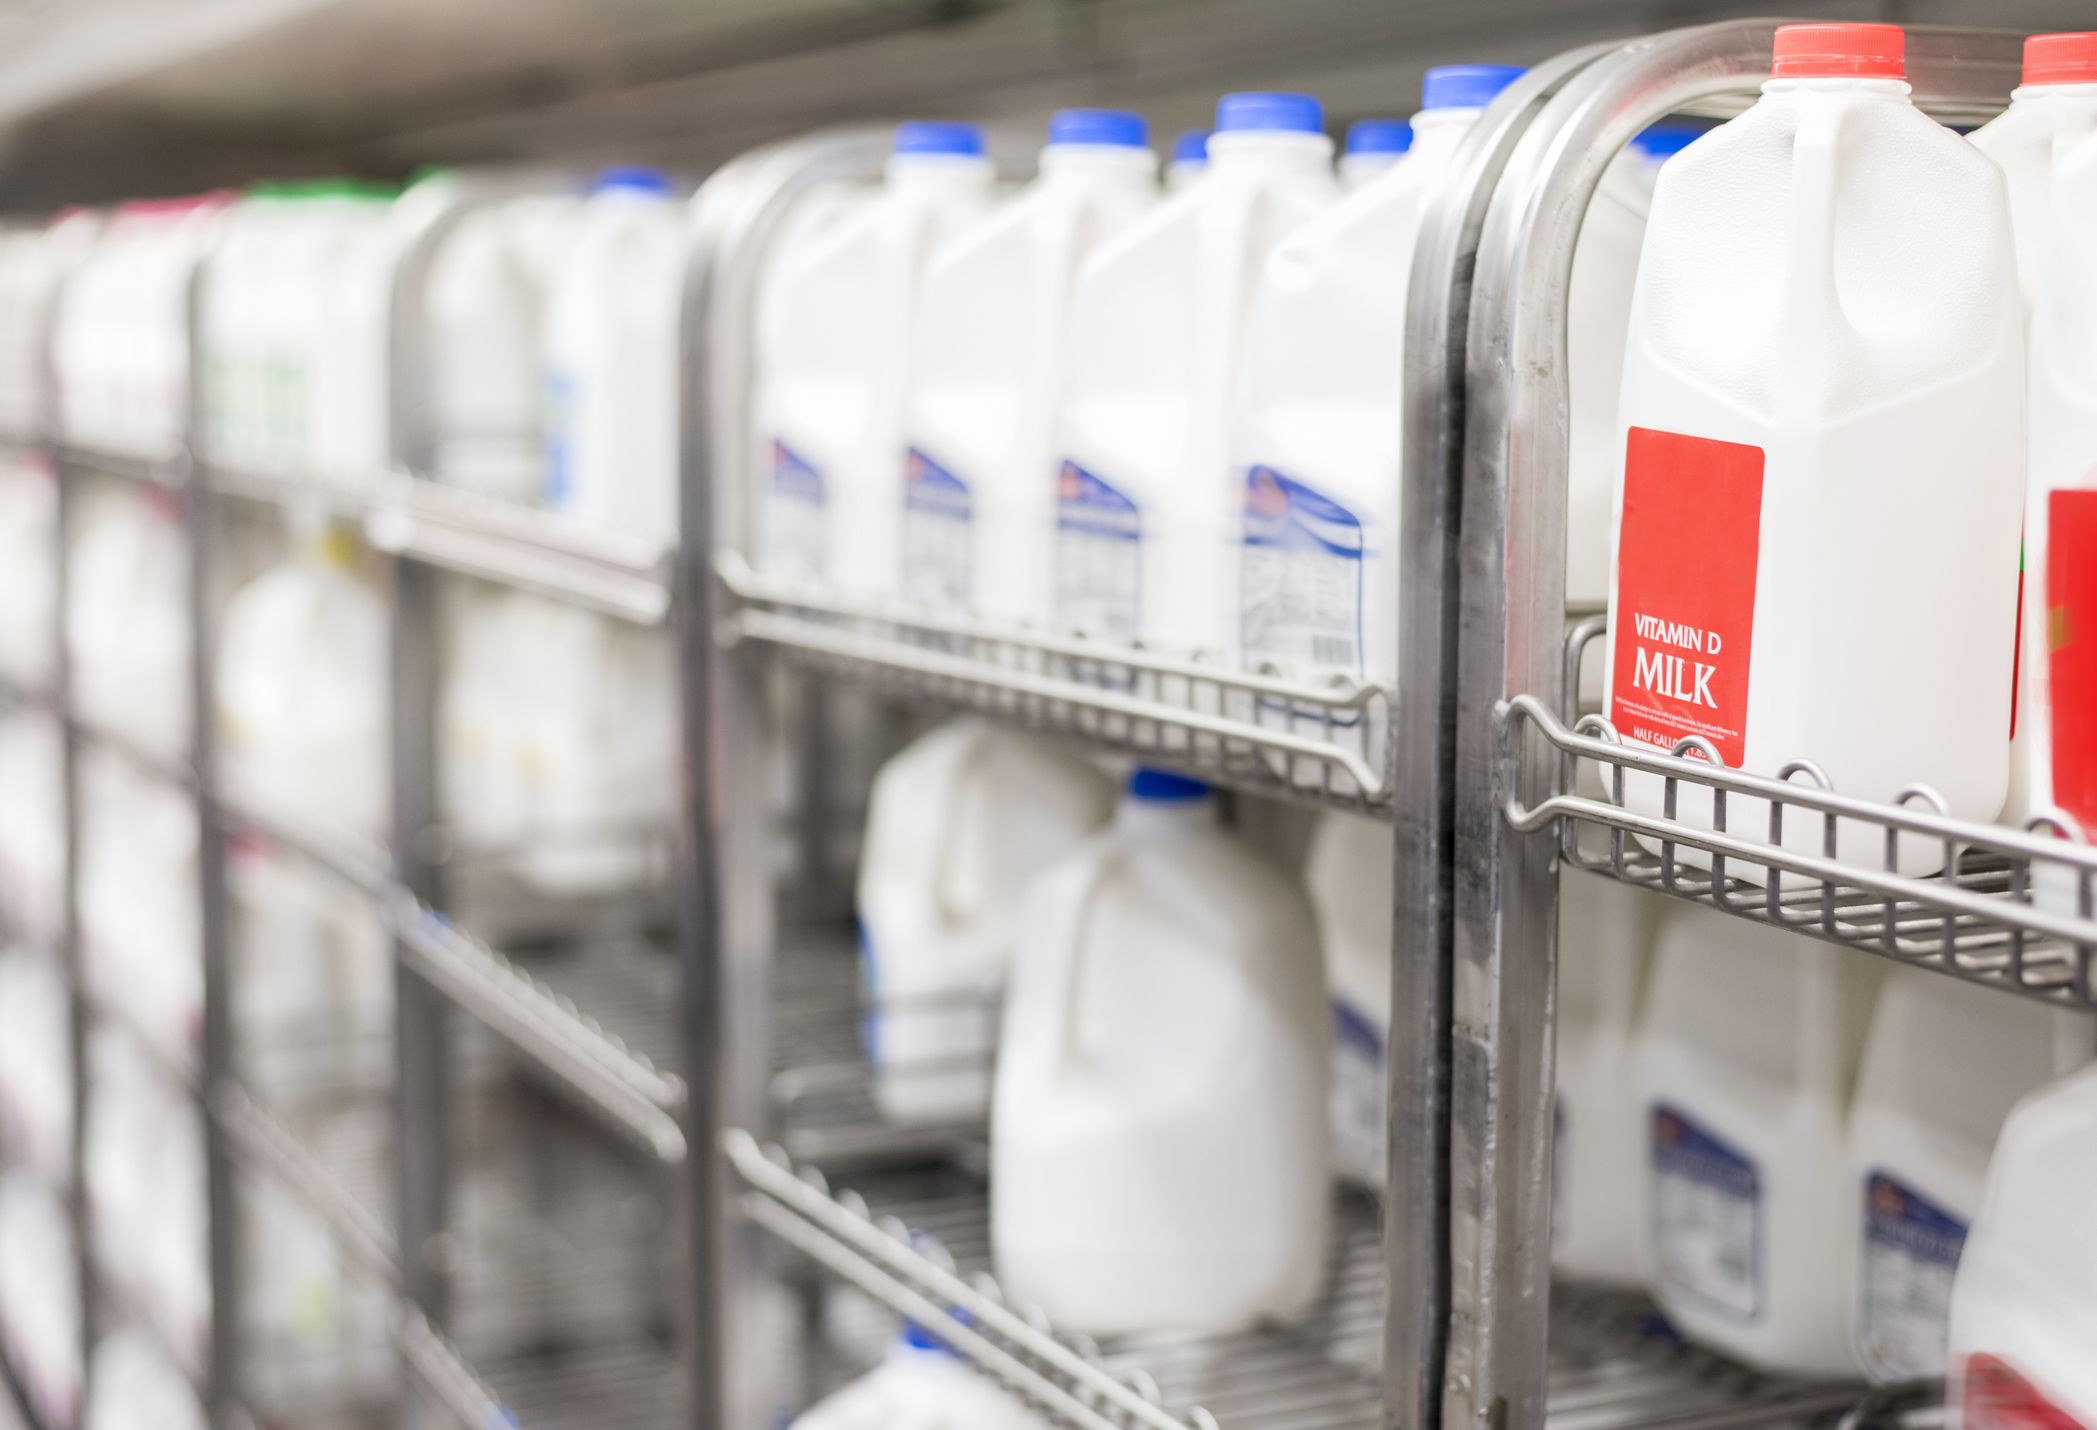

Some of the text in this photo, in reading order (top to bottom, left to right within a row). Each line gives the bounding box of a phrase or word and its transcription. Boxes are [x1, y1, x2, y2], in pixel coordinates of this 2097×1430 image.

[1634, 612, 1722, 655] VITAMIN D
[1632, 646, 1718, 709] MILK
[1633, 725, 1653, 742] HALF
[1653, 732, 1679, 749] GALLO
